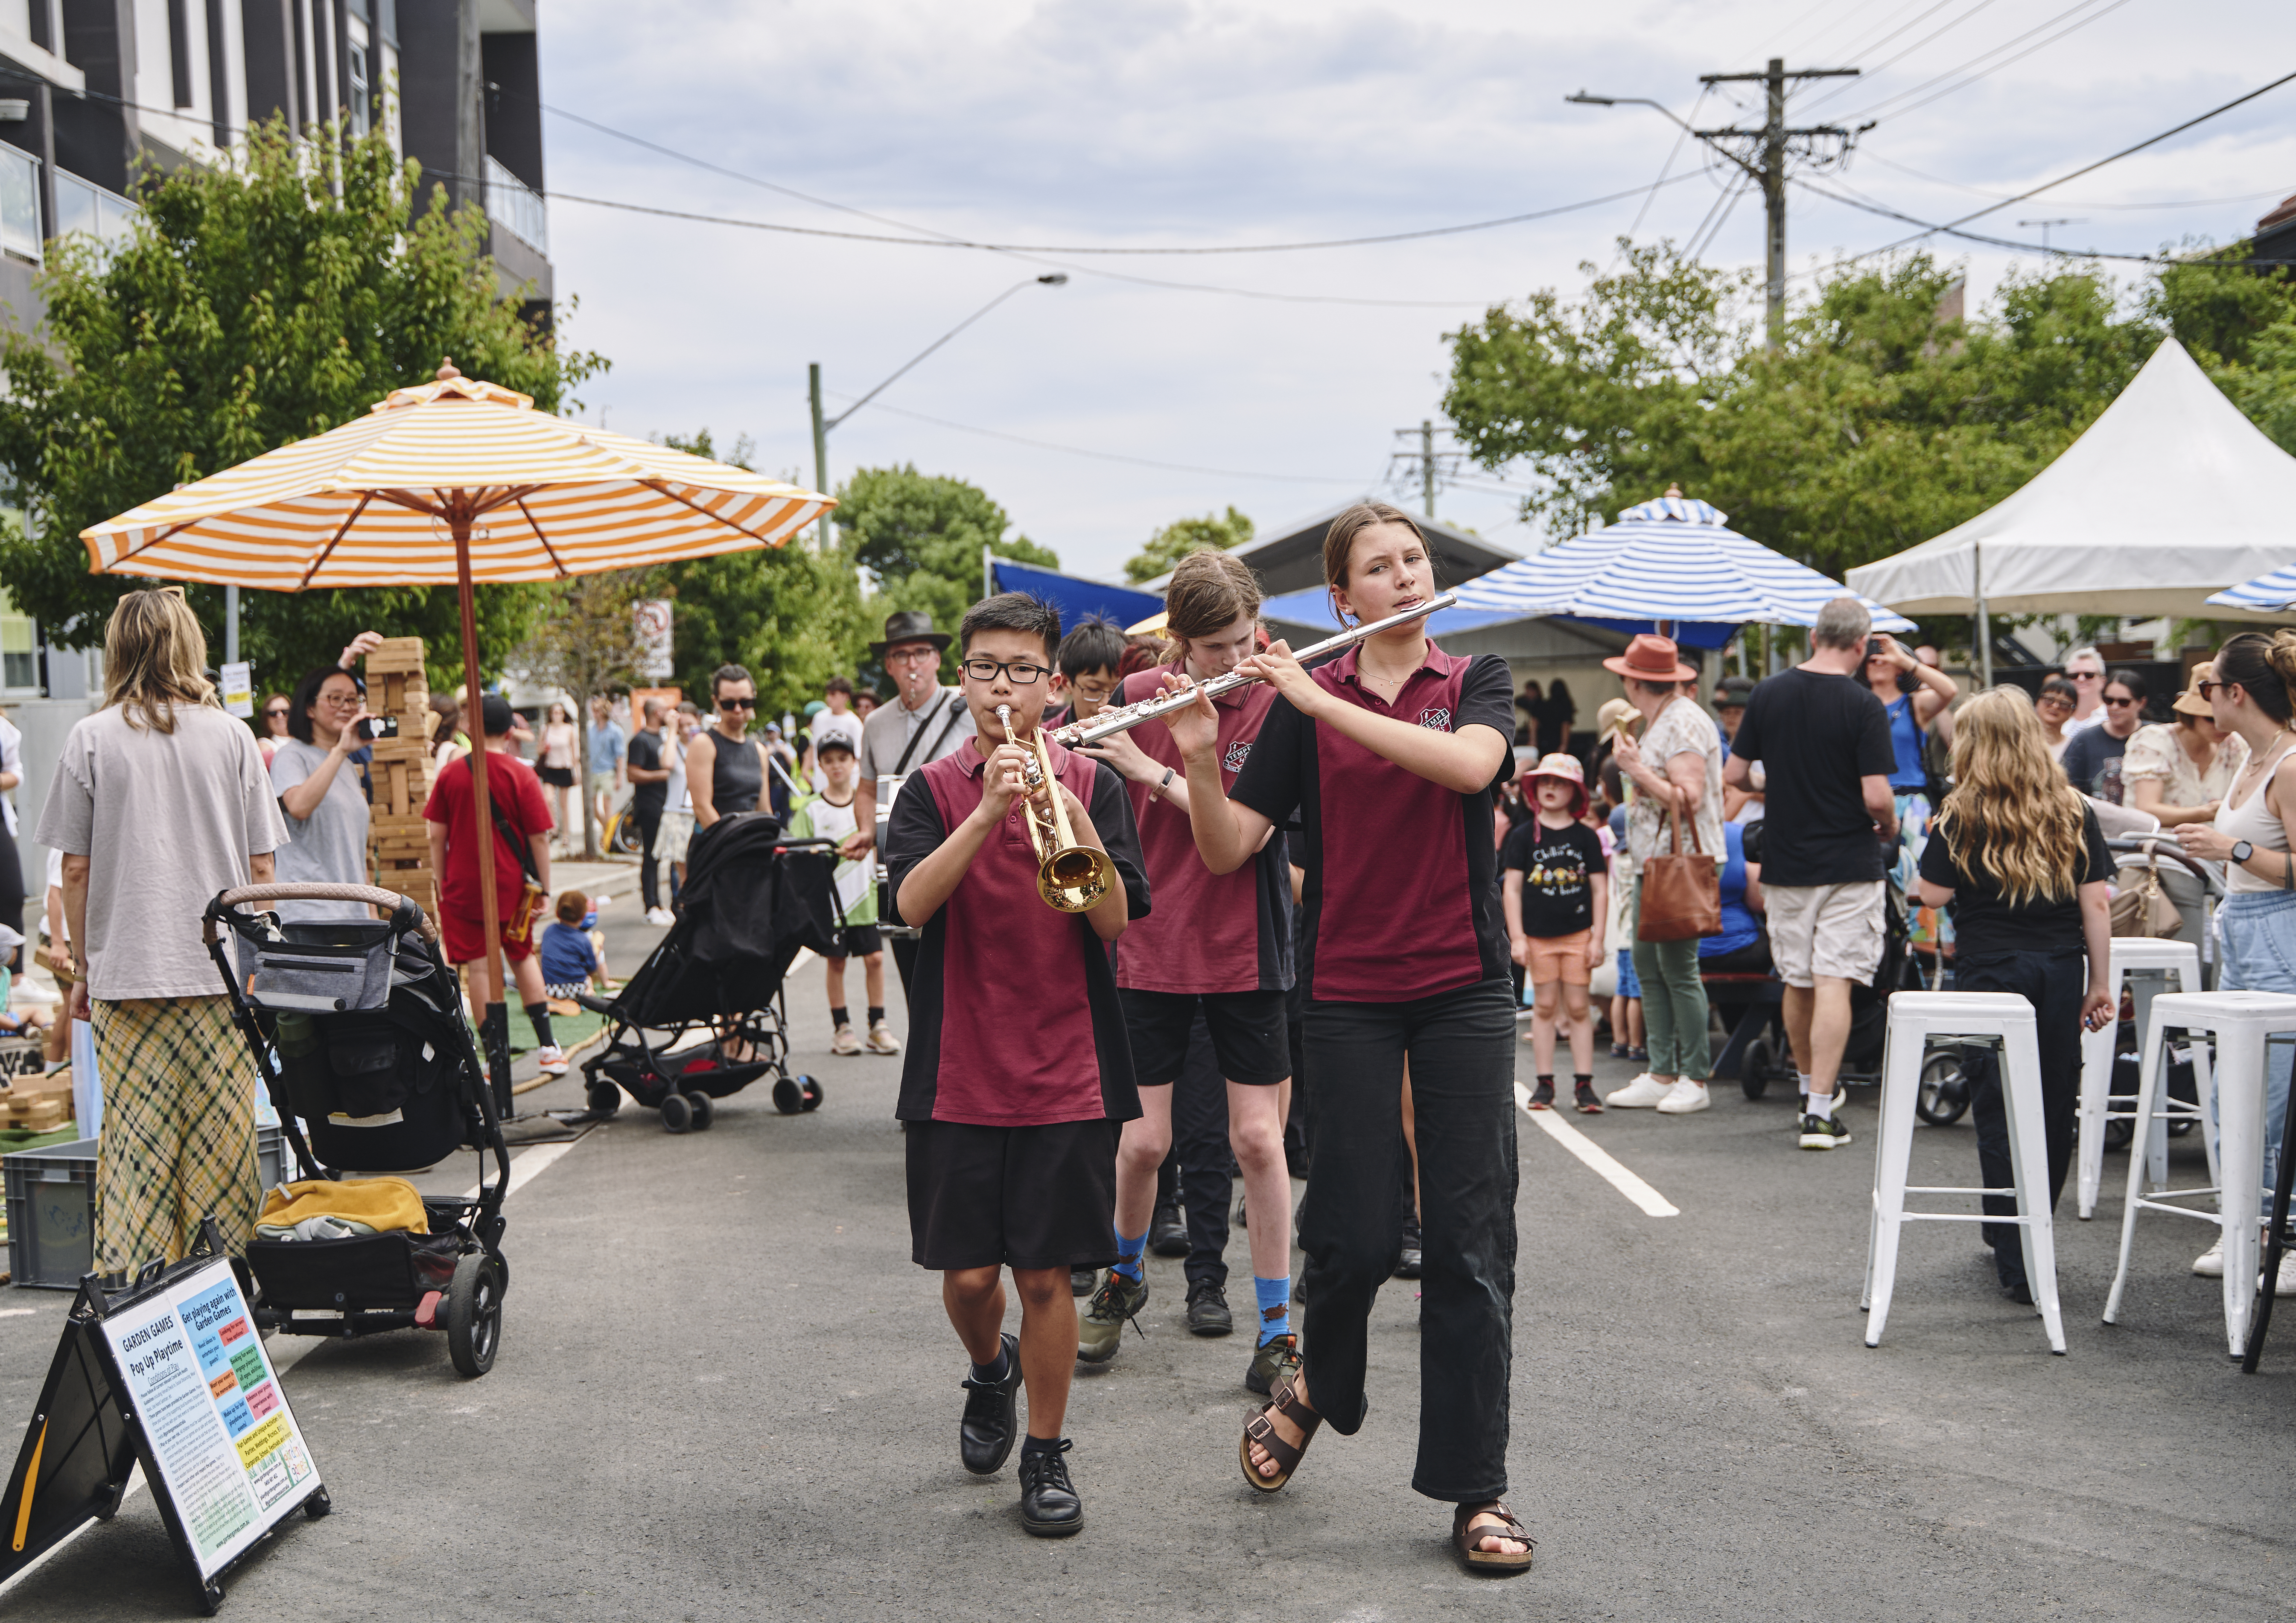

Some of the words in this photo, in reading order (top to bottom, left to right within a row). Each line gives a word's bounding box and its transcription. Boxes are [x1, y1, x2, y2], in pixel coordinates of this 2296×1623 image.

[1424, 711, 1446, 728] EMPE
[1229, 746, 1251, 760] TEMPE
[182, 1312, 193, 1323] Get
[192, 1302, 211, 1321] playing
[210, 1294, 225, 1309] again
[223, 1287, 236, 1300] with
[195, 1315, 214, 1331] Garden
[213, 1305, 231, 1320] Games
[123, 1328, 152, 1352] GARDEN
[150, 1315, 173, 1337] GAMES
[219, 1327, 231, 1336] Looking
[235, 1319, 244, 1327] screen
[233, 1328, 243, 1339] options?
[198, 1340, 206, 1349] Need
[130, 1361, 144, 1376] Pop
[143, 1355, 155, 1370] Up
[153, 1340, 183, 1363] Playtime
[202, 1348, 214, 1358] entertain
[209, 1354, 219, 1367] guests?
[230, 1355, 242, 1364] Seeking
[236, 1364, 246, 1372] engage
[245, 1358, 256, 1368] players
[251, 1364, 262, 1374] abilities
[148, 1369, 167, 1386] Conditions
[167, 1365, 171, 1374] of
[170, 1363, 180, 1371] Play
[248, 1371, 265, 1387] nationalities?
[220, 1380, 235, 1394] memorable?
[246, 1393, 258, 1402] Enhance
[263, 1383, 271, 1392] picnic
[143, 1397, 155, 1405] Guidelines
[171, 1397, 180, 1407] provided
[253, 1397, 267, 1409] experience
[197, 1413, 207, 1423] supervised
[223, 1410, 232, 1418] Make
[262, 1404, 271, 1416] games!
[229, 1414, 242, 1428] playdates
[237, 1420, 247, 1431] events!
[243, 1435, 253, 1445] Games
[257, 1425, 267, 1434] Unique
[266, 1416, 278, 1428] Activities
[245, 1446, 256, 1456] Parties,
[254, 1437, 268, 1448] Weddings,
[267, 1430, 278, 1439] Picnics,
[245, 1456, 261, 1469] Corporate,
[259, 1447, 270, 1458] School,
[268, 1439, 281, 1451] Festivals
[283, 1444, 302, 1468] garden
[254, 1462, 282, 1484] www.gardengames.com.au
[291, 1457, 308, 1482] games
[260, 1476, 288, 1501] play@gardengames.com.au
[265, 1484, 289, 1506] @gardengamesaustralia
[216, 1520, 250, 1548] www.gardengames.com.au
